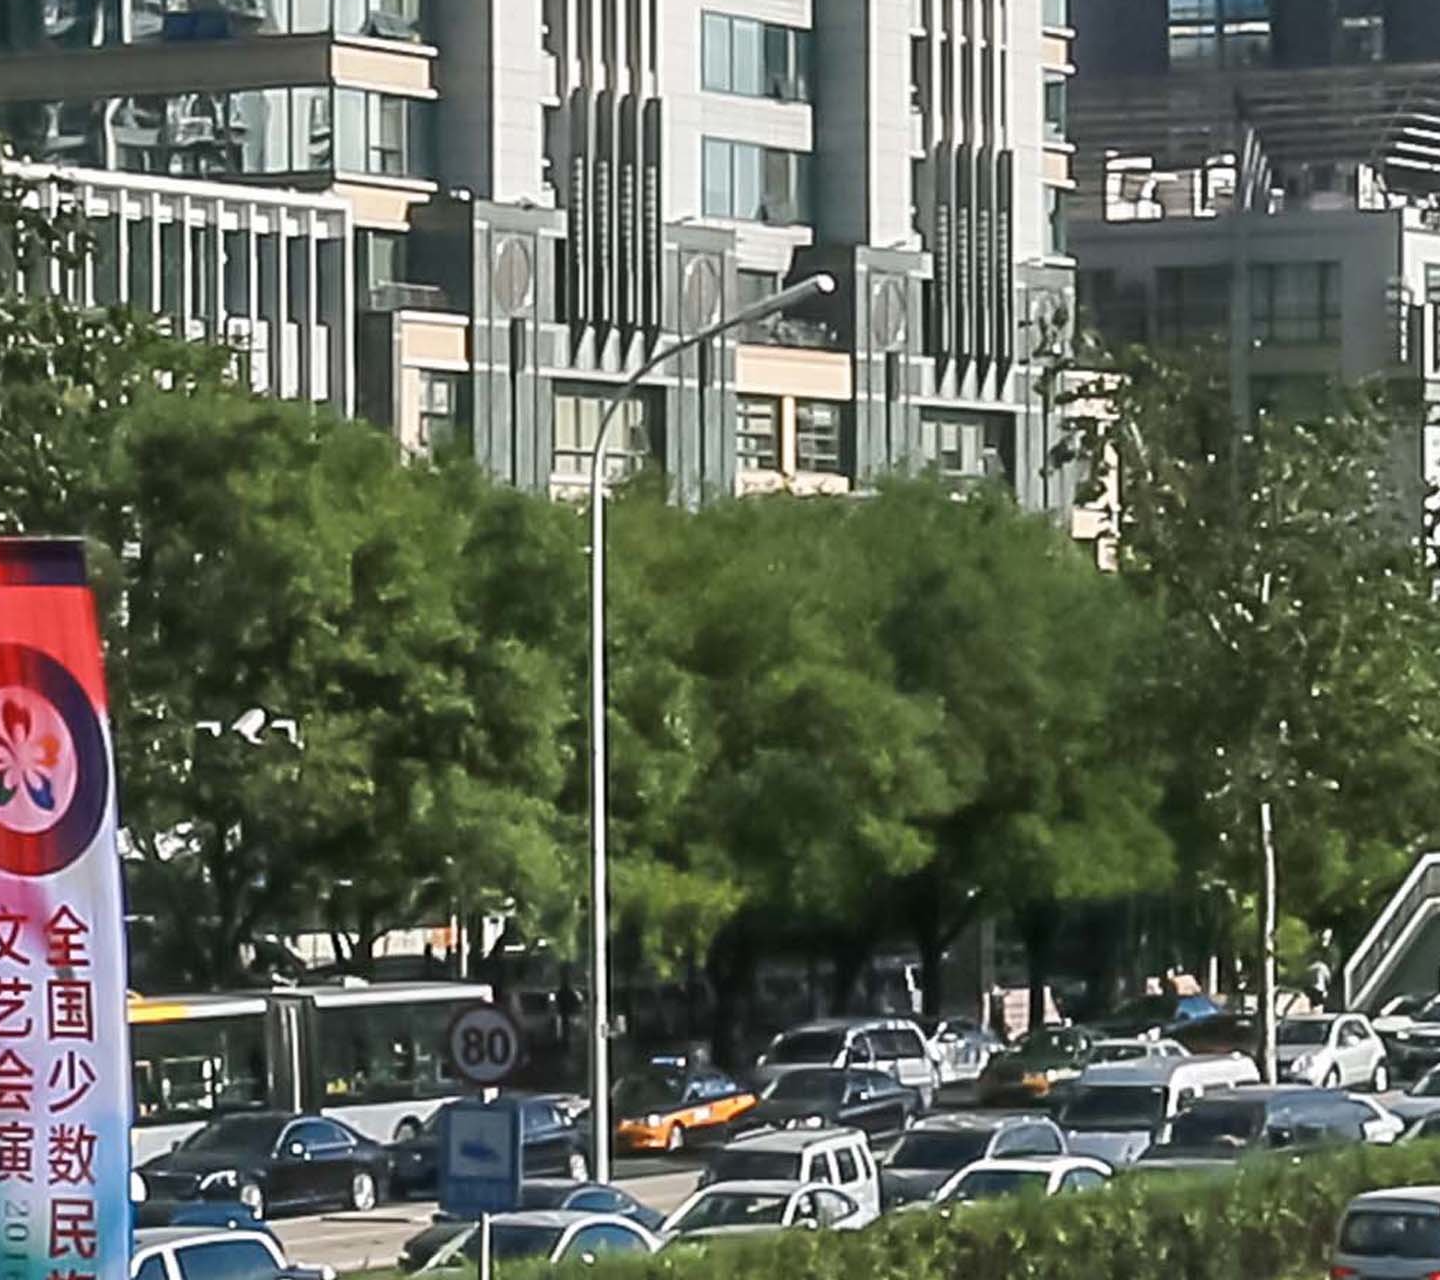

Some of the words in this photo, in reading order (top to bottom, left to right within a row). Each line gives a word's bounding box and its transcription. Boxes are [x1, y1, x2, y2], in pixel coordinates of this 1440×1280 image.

[44, 905, 99, 1280] 全国少数民
[460, 1026, 511, 1066] 80
